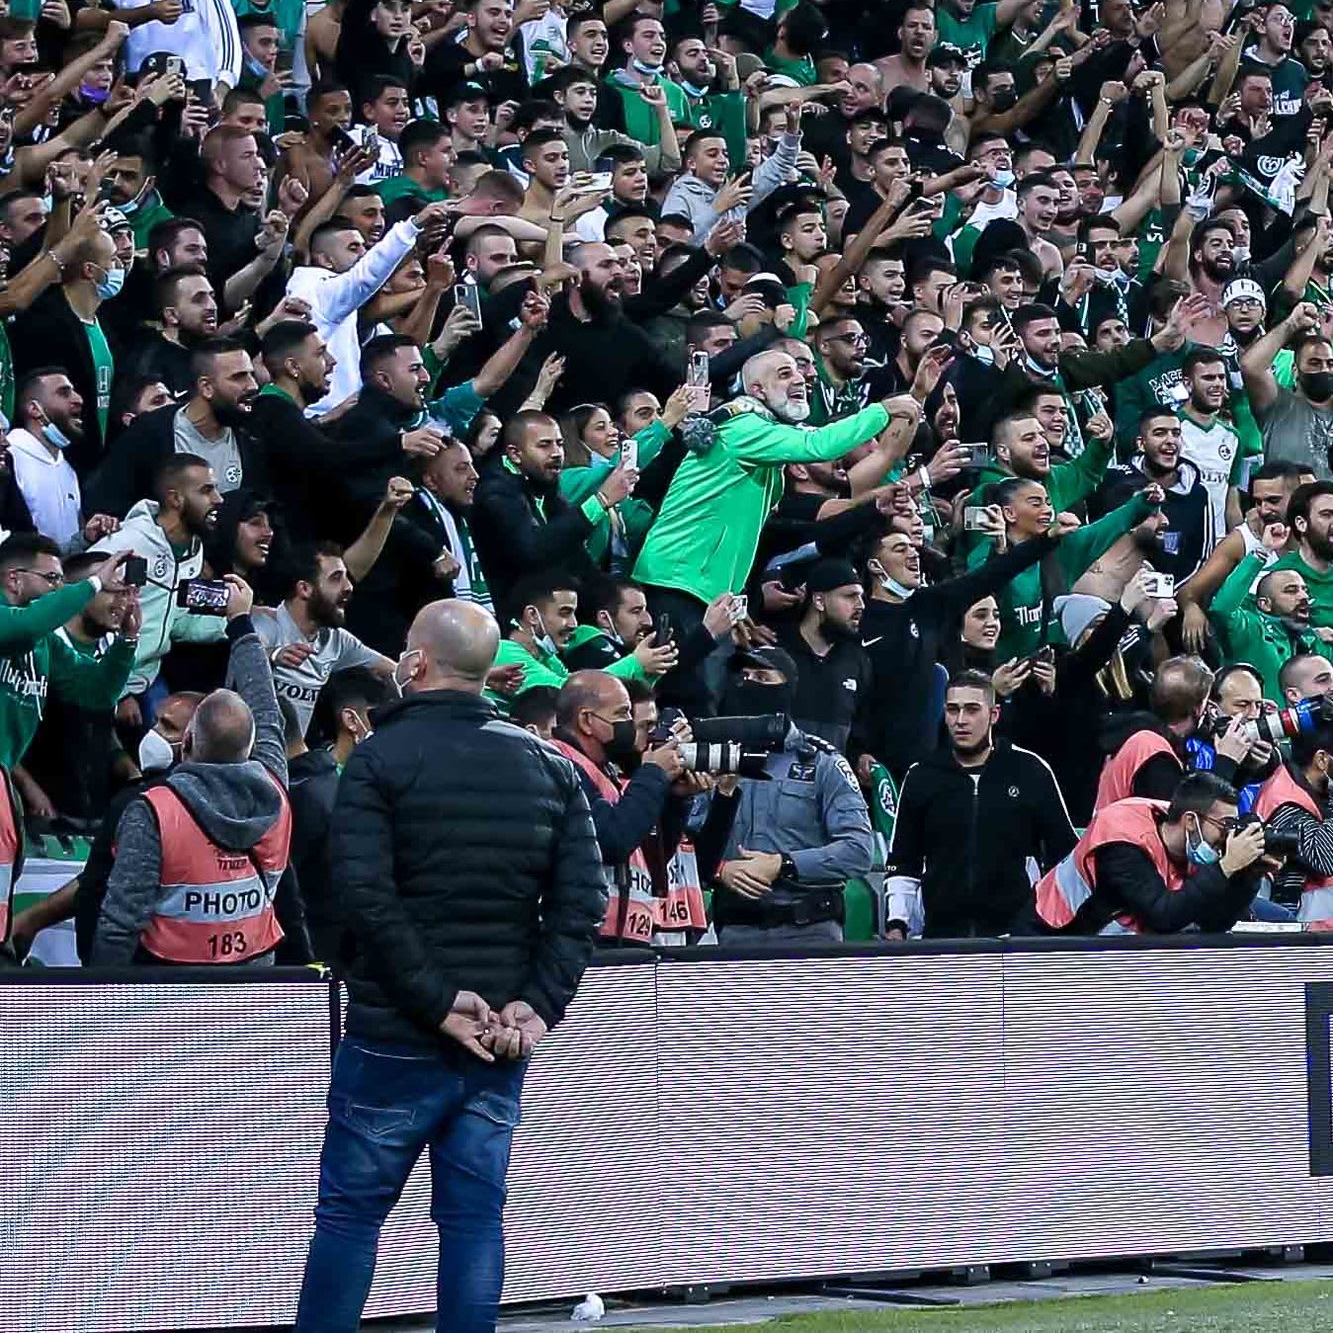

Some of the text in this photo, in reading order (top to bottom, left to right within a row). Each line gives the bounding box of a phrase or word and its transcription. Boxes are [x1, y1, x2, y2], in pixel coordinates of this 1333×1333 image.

[184, 887, 261, 916] PHOTO
[660, 901, 689, 922] 146
[208, 931, 248, 957] 183
